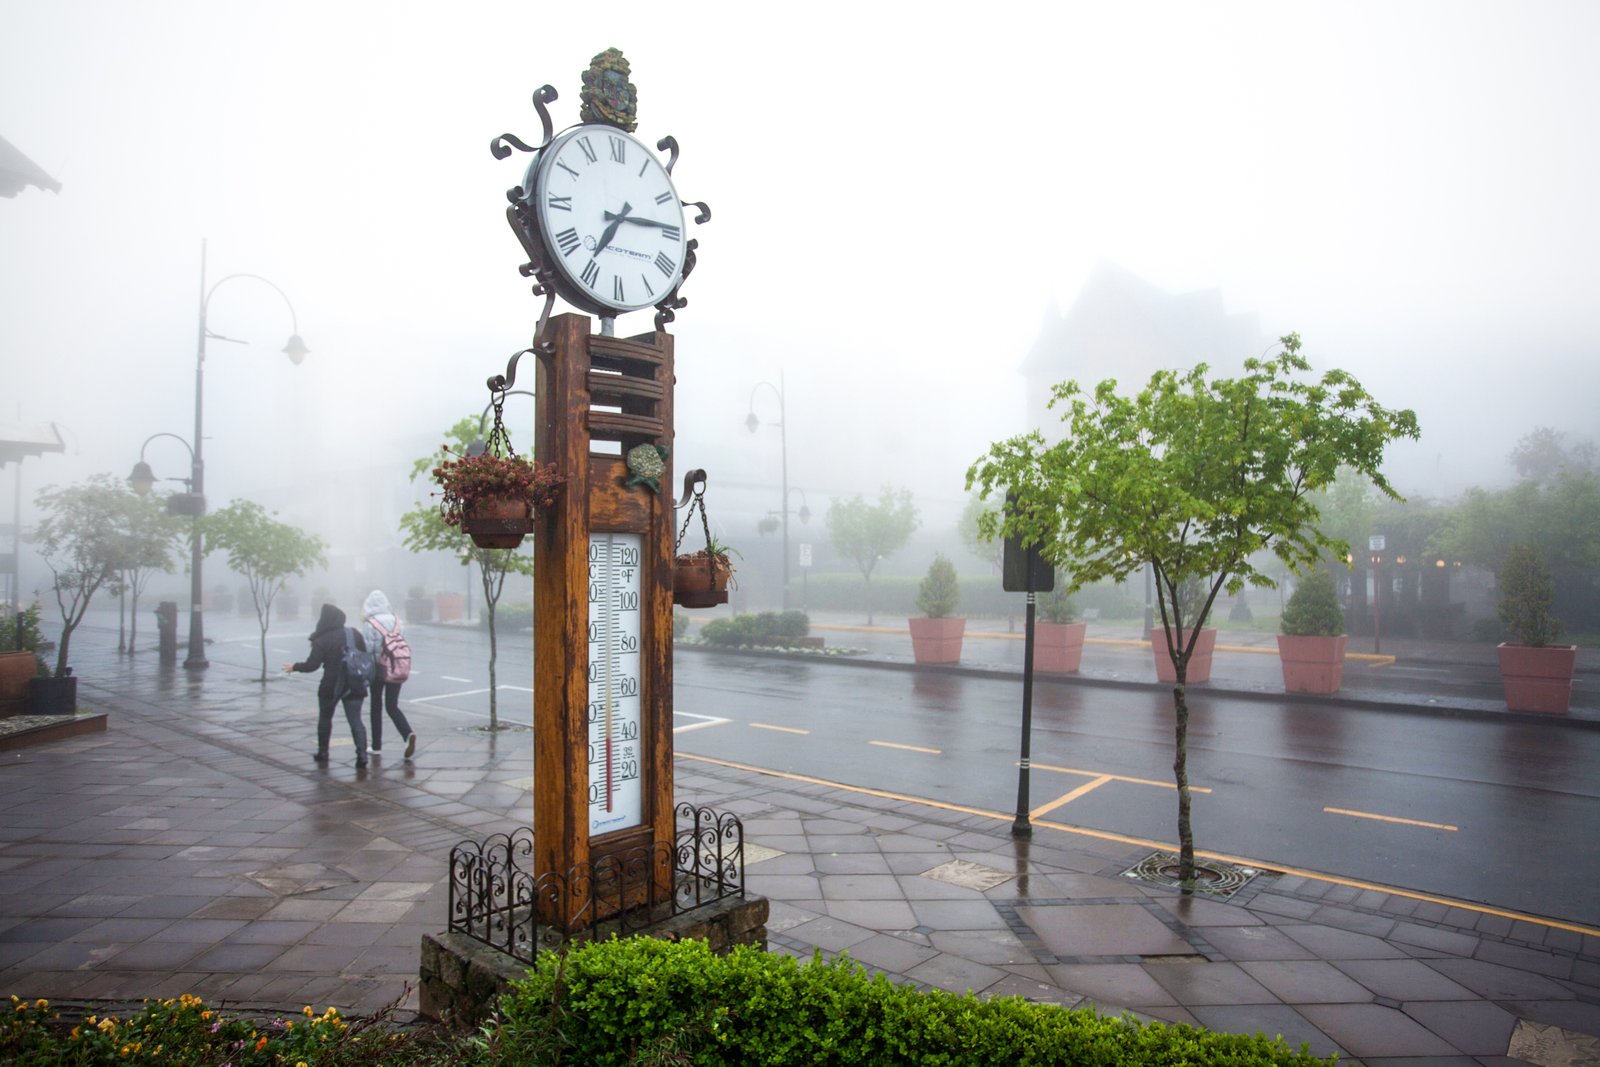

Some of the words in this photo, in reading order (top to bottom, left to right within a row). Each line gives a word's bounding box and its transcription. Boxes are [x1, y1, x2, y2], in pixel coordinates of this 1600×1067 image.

[576, 136, 598, 166] XI
[608, 135, 626, 165] XII
[556, 156, 580, 182] X
[638, 158, 651, 178] I
[548, 191, 572, 212] IX
[654, 190, 673, 206] II
[555, 227, 582, 258] VIII
[580, 258, 600, 290] VII
[613, 275, 625, 302] VI
[641, 272, 655, 298] V
[620, 547, 638, 565] 120
[620, 591, 638, 609] 100
[620, 635, 637, 651] 80
[620, 677, 637, 695] 60
[621, 720, 637, 739] 40
[621, 759, 637, 779] 20
